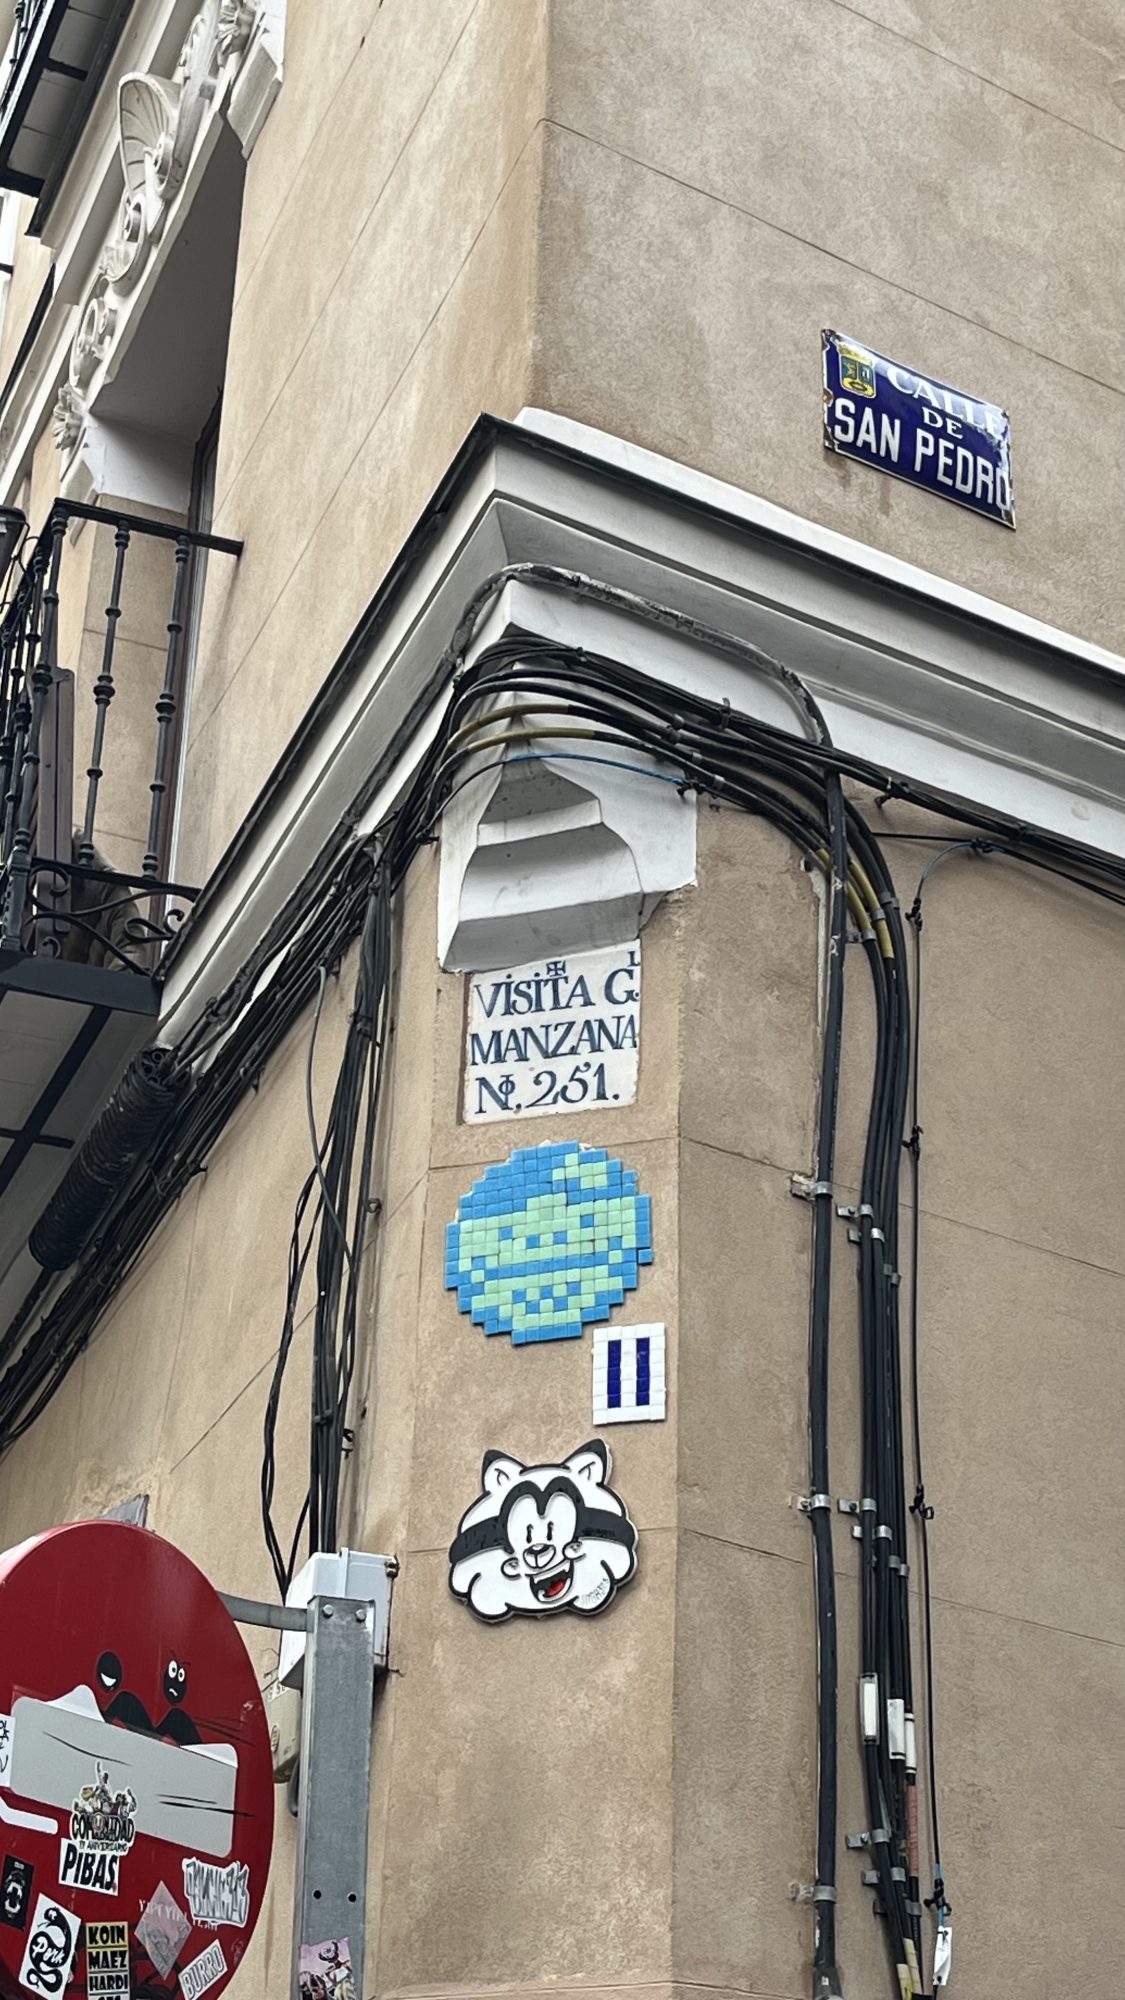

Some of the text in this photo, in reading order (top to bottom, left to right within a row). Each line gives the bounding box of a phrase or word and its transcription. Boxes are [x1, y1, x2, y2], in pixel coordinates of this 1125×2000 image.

[887, 366, 1007, 441] CALLE
[922, 406, 963, 440] DE
[834, 397, 1012, 511] SAN PEDRO
[473, 972, 596, 1018] VISITA
[470, 1014, 638, 1066] MANZANA
[61, 1842, 118, 1891] PIBAS
[88, 1925, 125, 1945] KOIN
[88, 1950, 128, 1970] MAEZ
[89, 1974, 128, 1992] HARDI
